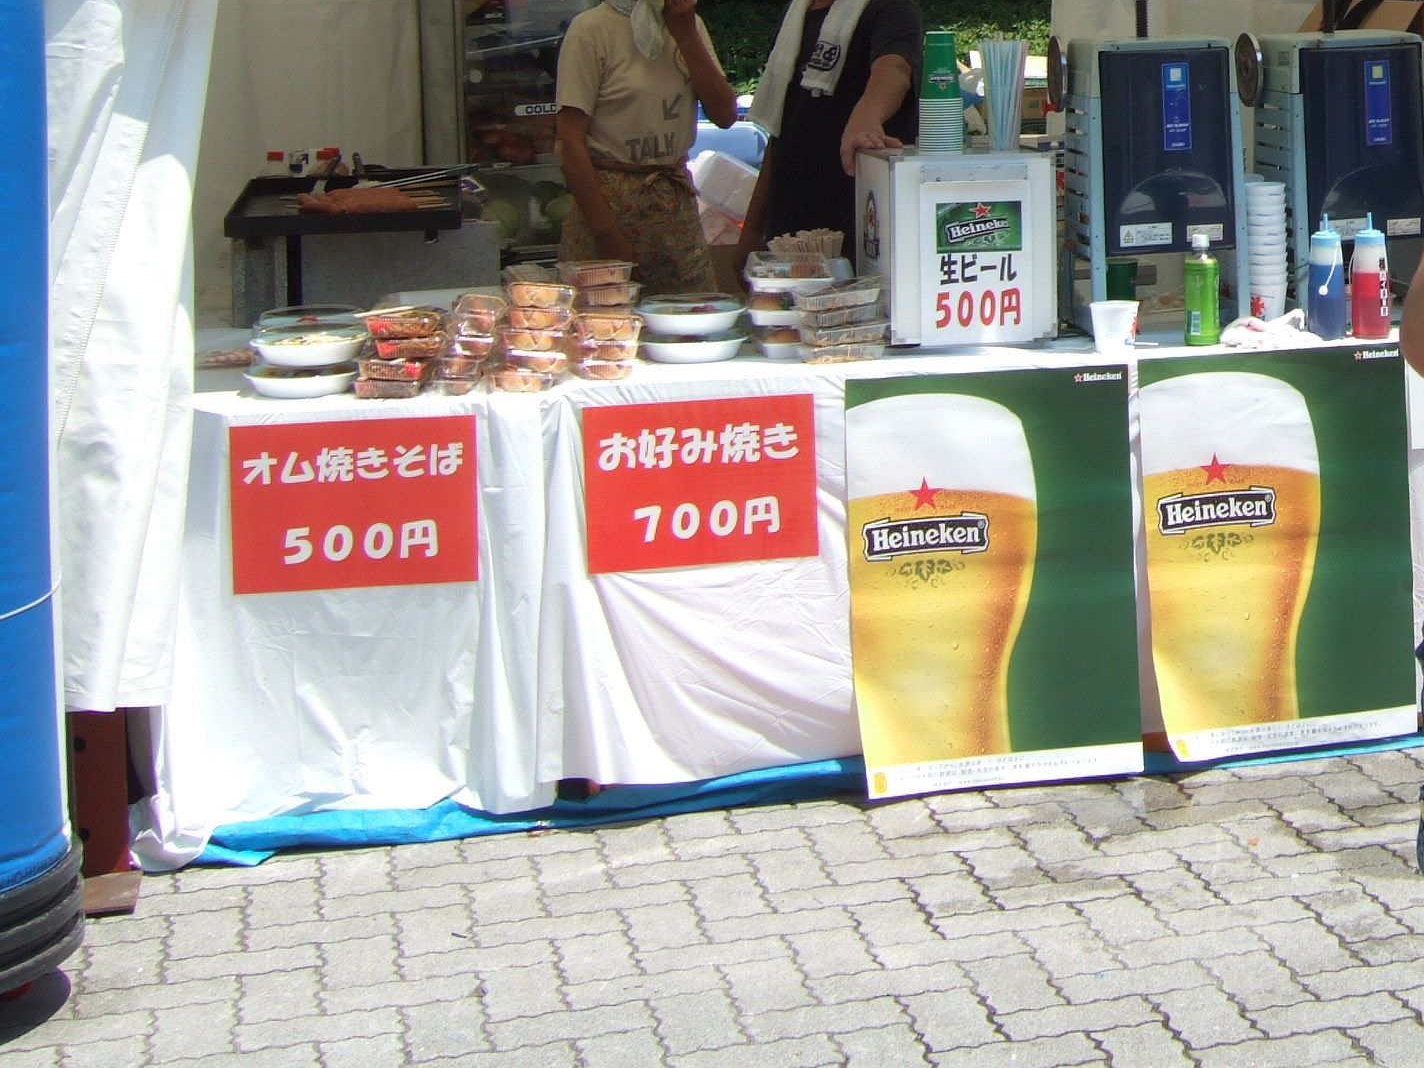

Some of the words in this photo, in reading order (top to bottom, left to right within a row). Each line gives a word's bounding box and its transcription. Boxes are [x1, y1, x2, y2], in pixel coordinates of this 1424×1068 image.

[939, 253, 1018, 286] 生ビール
[935, 287, 1022, 330] 500円
[241, 442, 465, 486] オム焼きそば
[597, 420, 800, 474] お好み焼き
[633, 495, 781, 543] 700円
[1165, 496, 1268, 527] Heineken
[282, 518, 440, 566] 500円
[871, 522, 982, 552] Heineken
